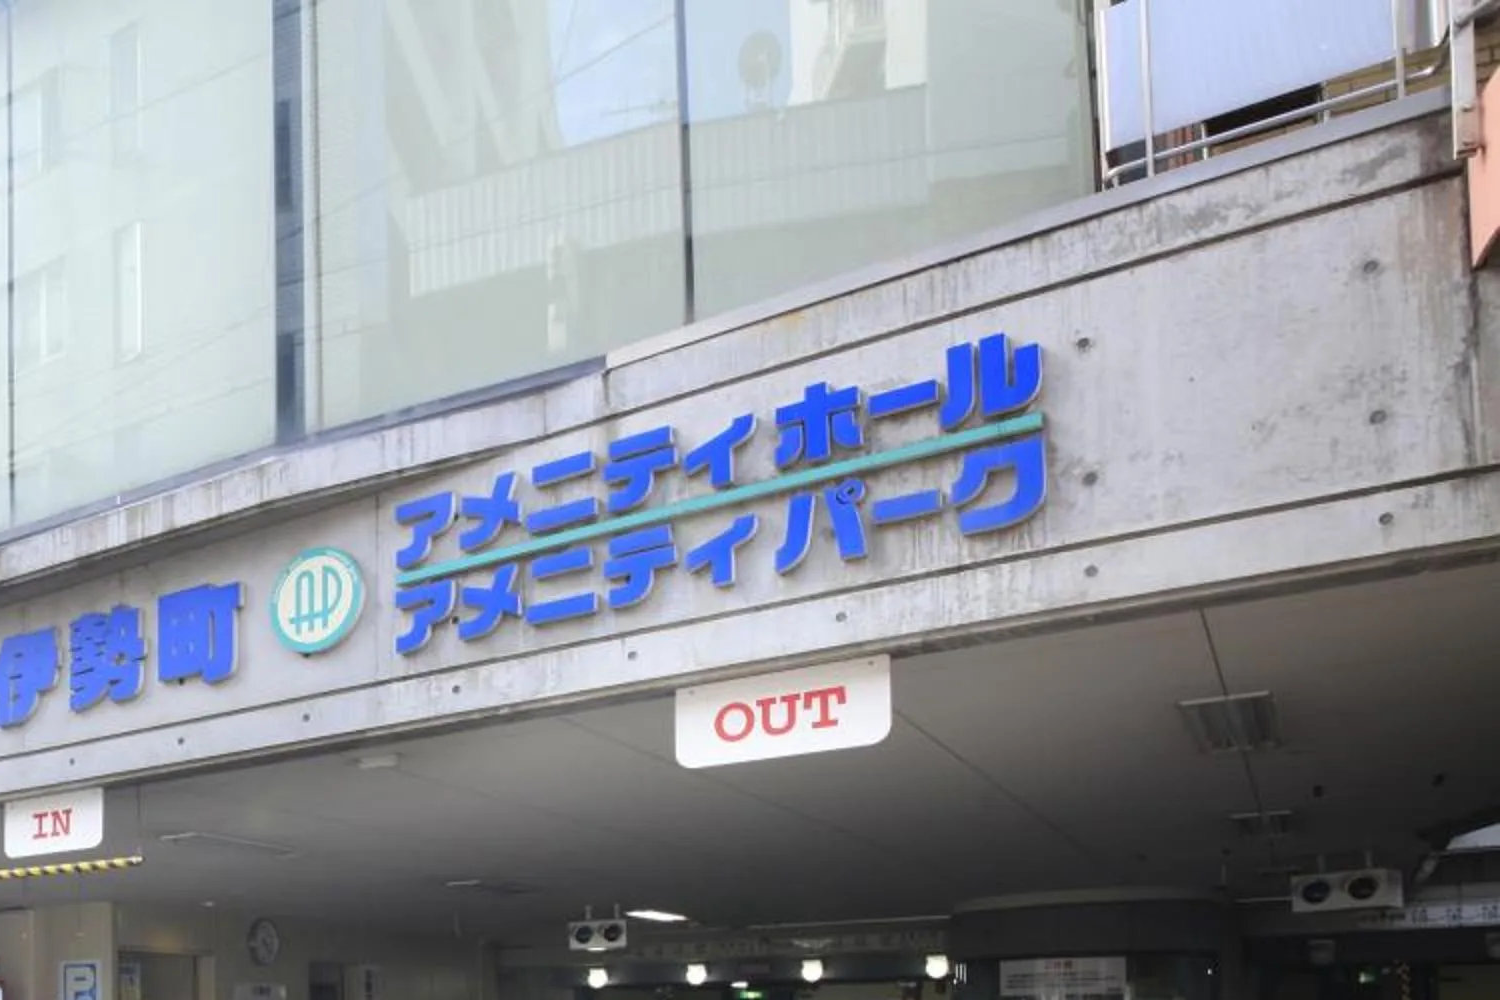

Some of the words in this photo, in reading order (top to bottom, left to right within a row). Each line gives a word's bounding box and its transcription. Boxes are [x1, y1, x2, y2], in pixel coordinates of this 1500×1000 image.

[396, 332, 1043, 570] アメニティホール
[396, 434, 1048, 656] アメニティパーク
[713, 684, 847, 743] OUT
[31, 808, 73, 839] IN
